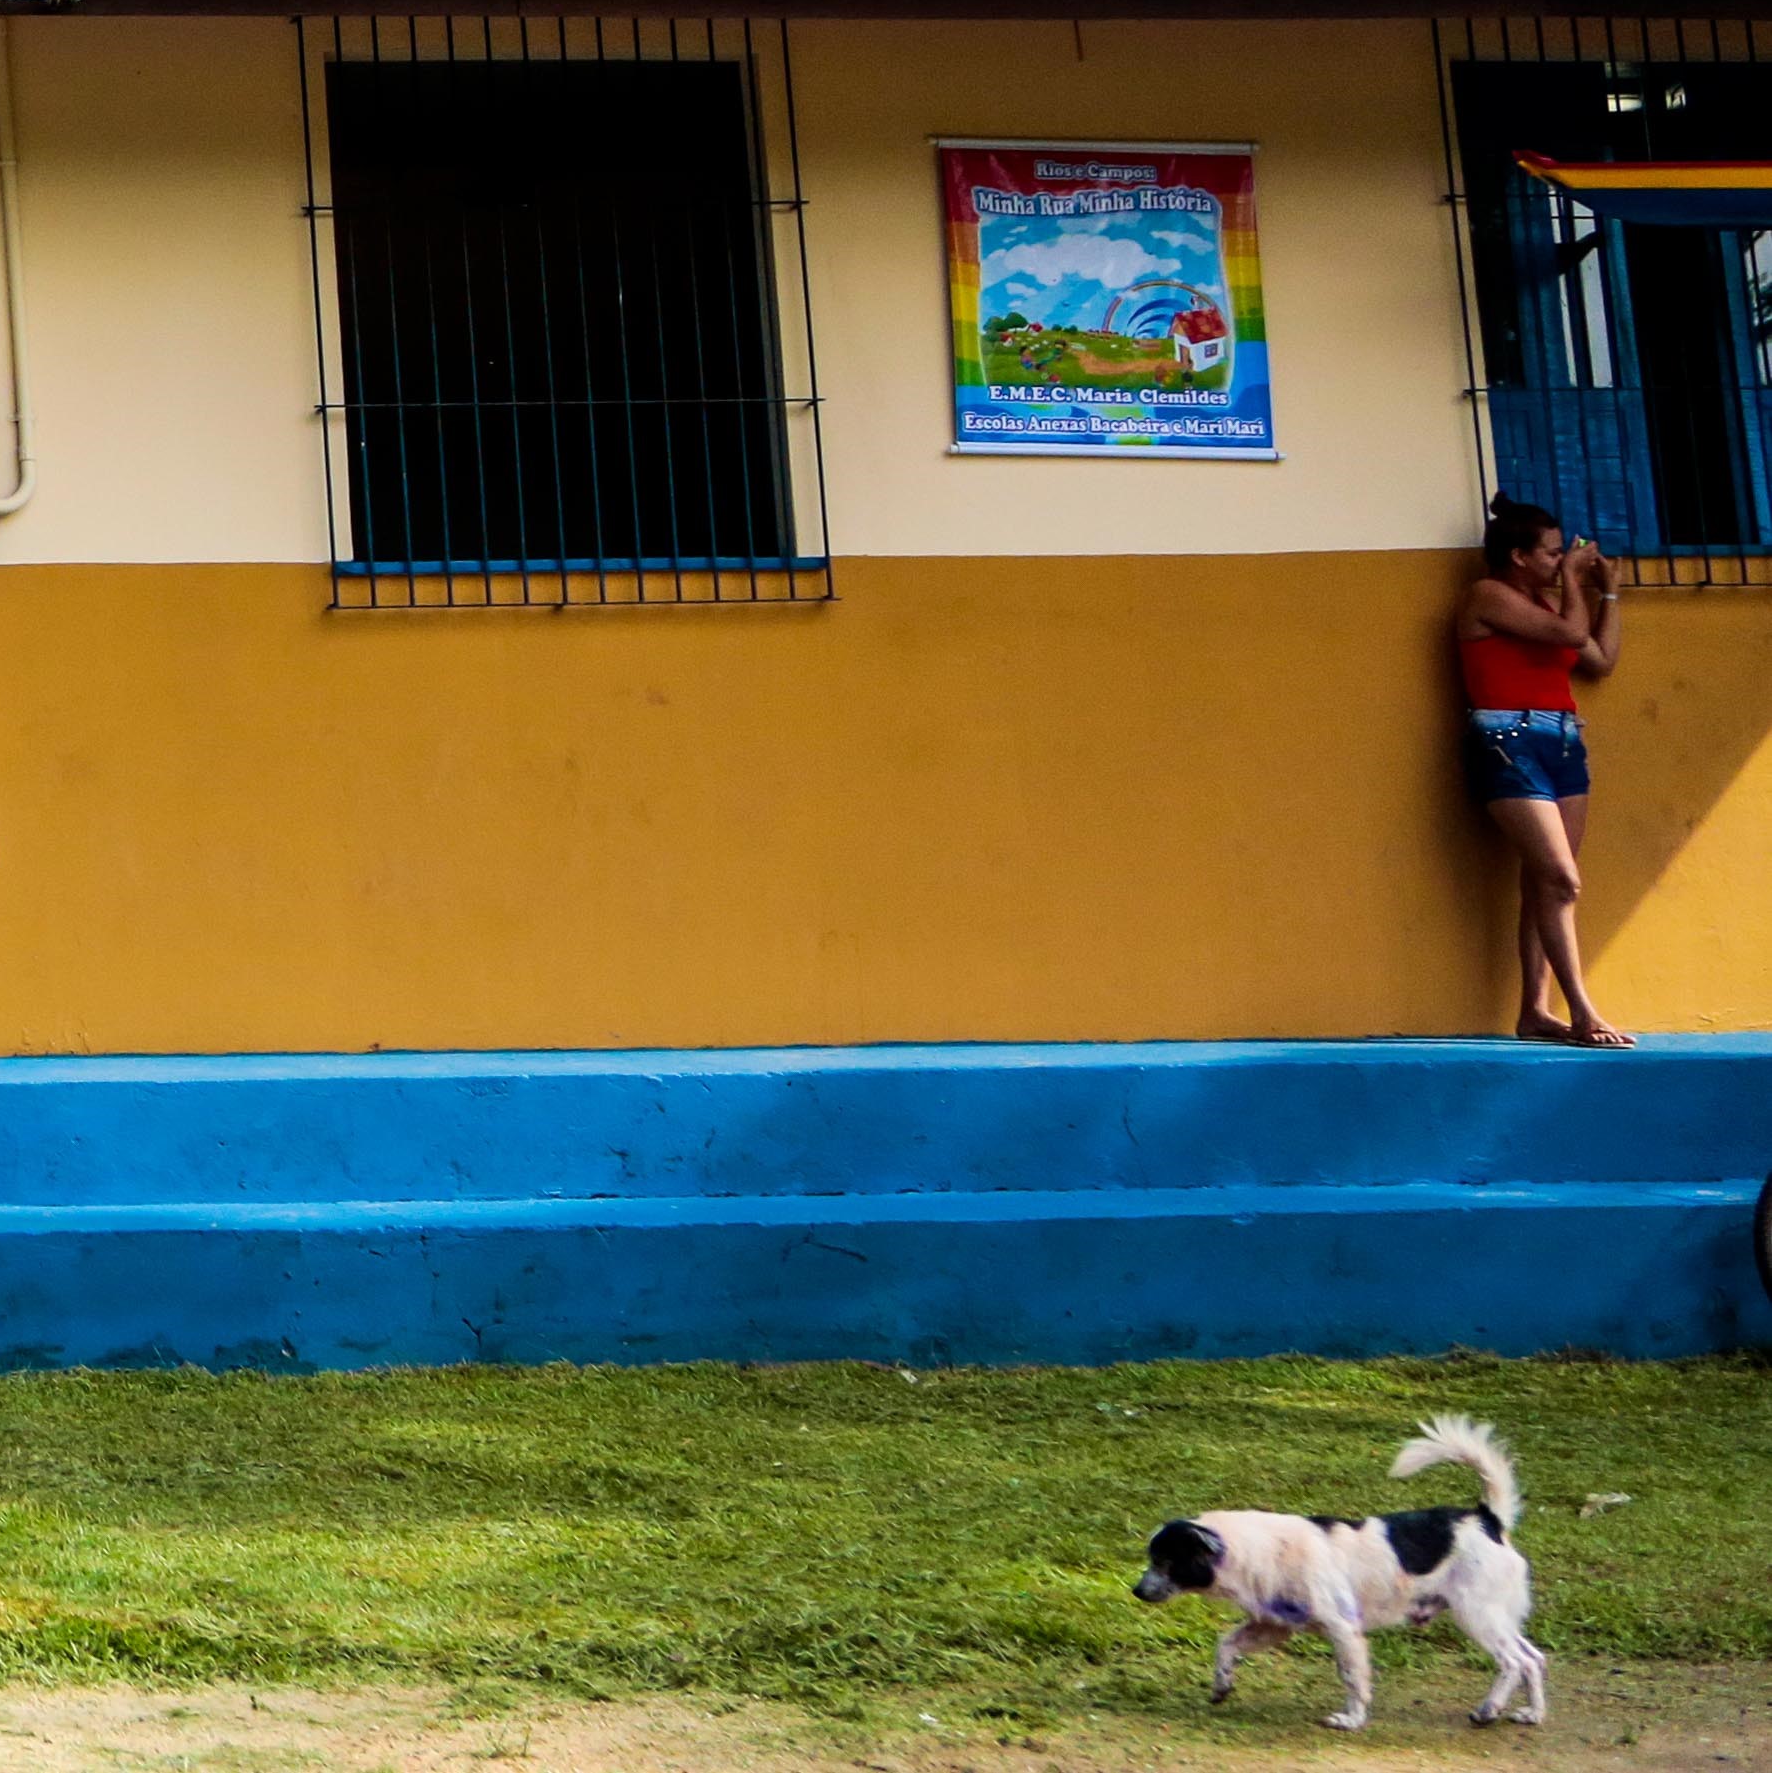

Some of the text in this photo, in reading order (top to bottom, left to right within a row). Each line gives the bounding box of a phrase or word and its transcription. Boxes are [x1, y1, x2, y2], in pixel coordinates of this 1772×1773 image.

[978, 188, 1212, 216] Minha Rua Minha História
[988, 385, 1228, 405] E.M.E.C. Maria Clemildes
[964, 414, 1023, 431] Escolas
[1028, 416, 1087, 432] Anexas
[1172, 423, 1183, 434] e
[1185, 418, 1224, 435] Mari
[1226, 419, 1264, 436] Mari
